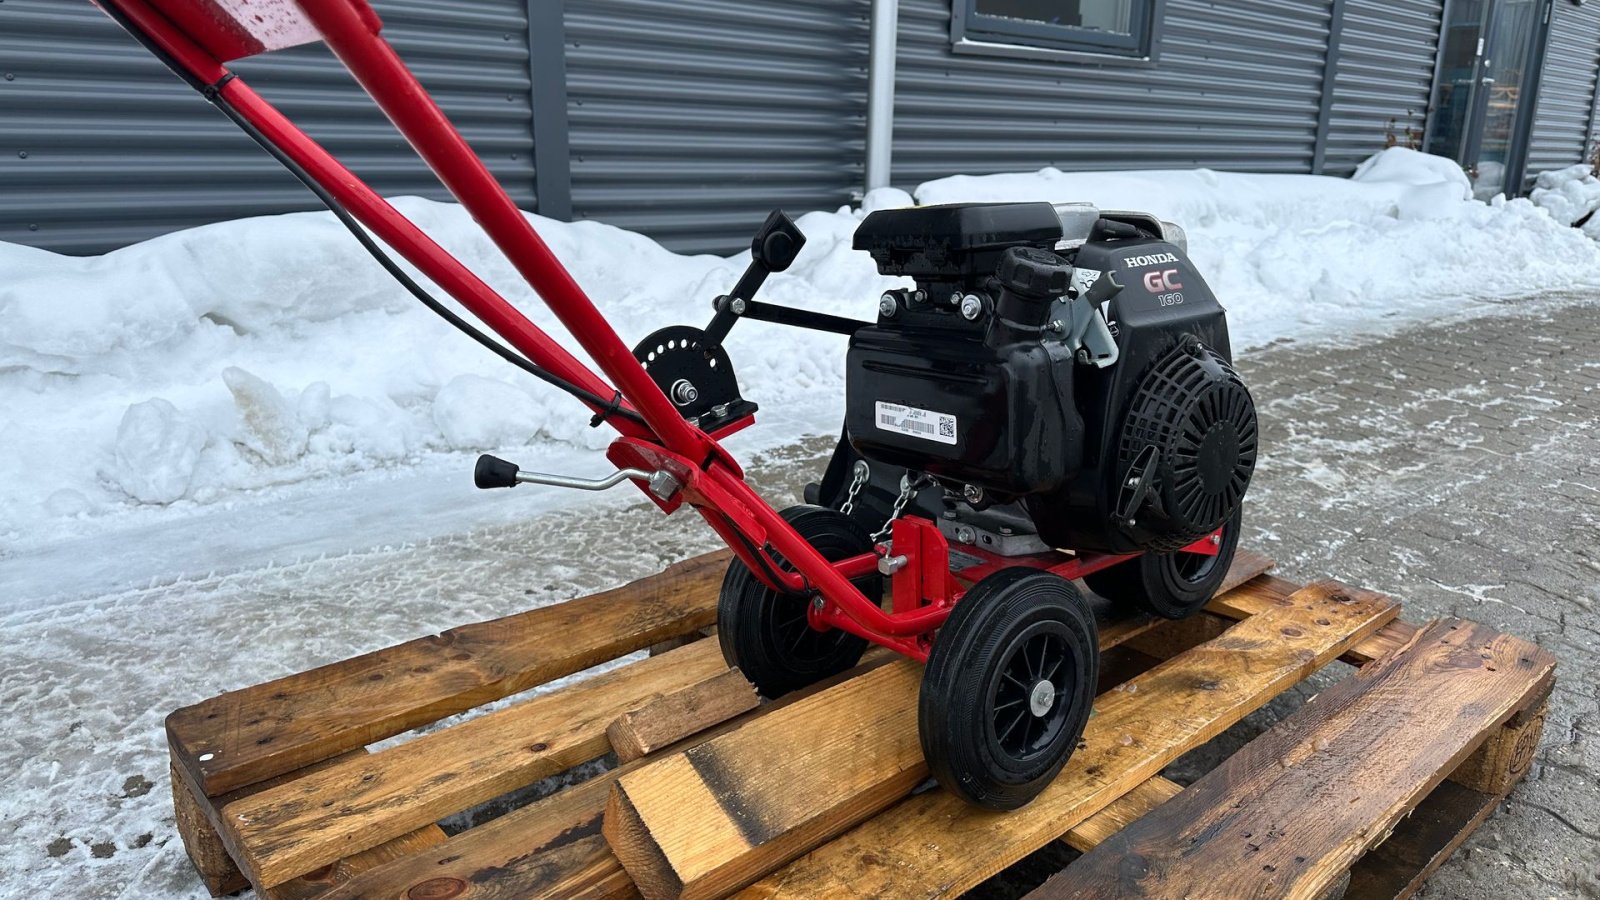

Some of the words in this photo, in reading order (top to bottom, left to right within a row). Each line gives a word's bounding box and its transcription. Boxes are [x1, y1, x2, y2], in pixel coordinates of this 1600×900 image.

[1123, 252, 1180, 268] HONDA
[1143, 268, 1183, 293] GC
[1158, 292, 1184, 307] 160
